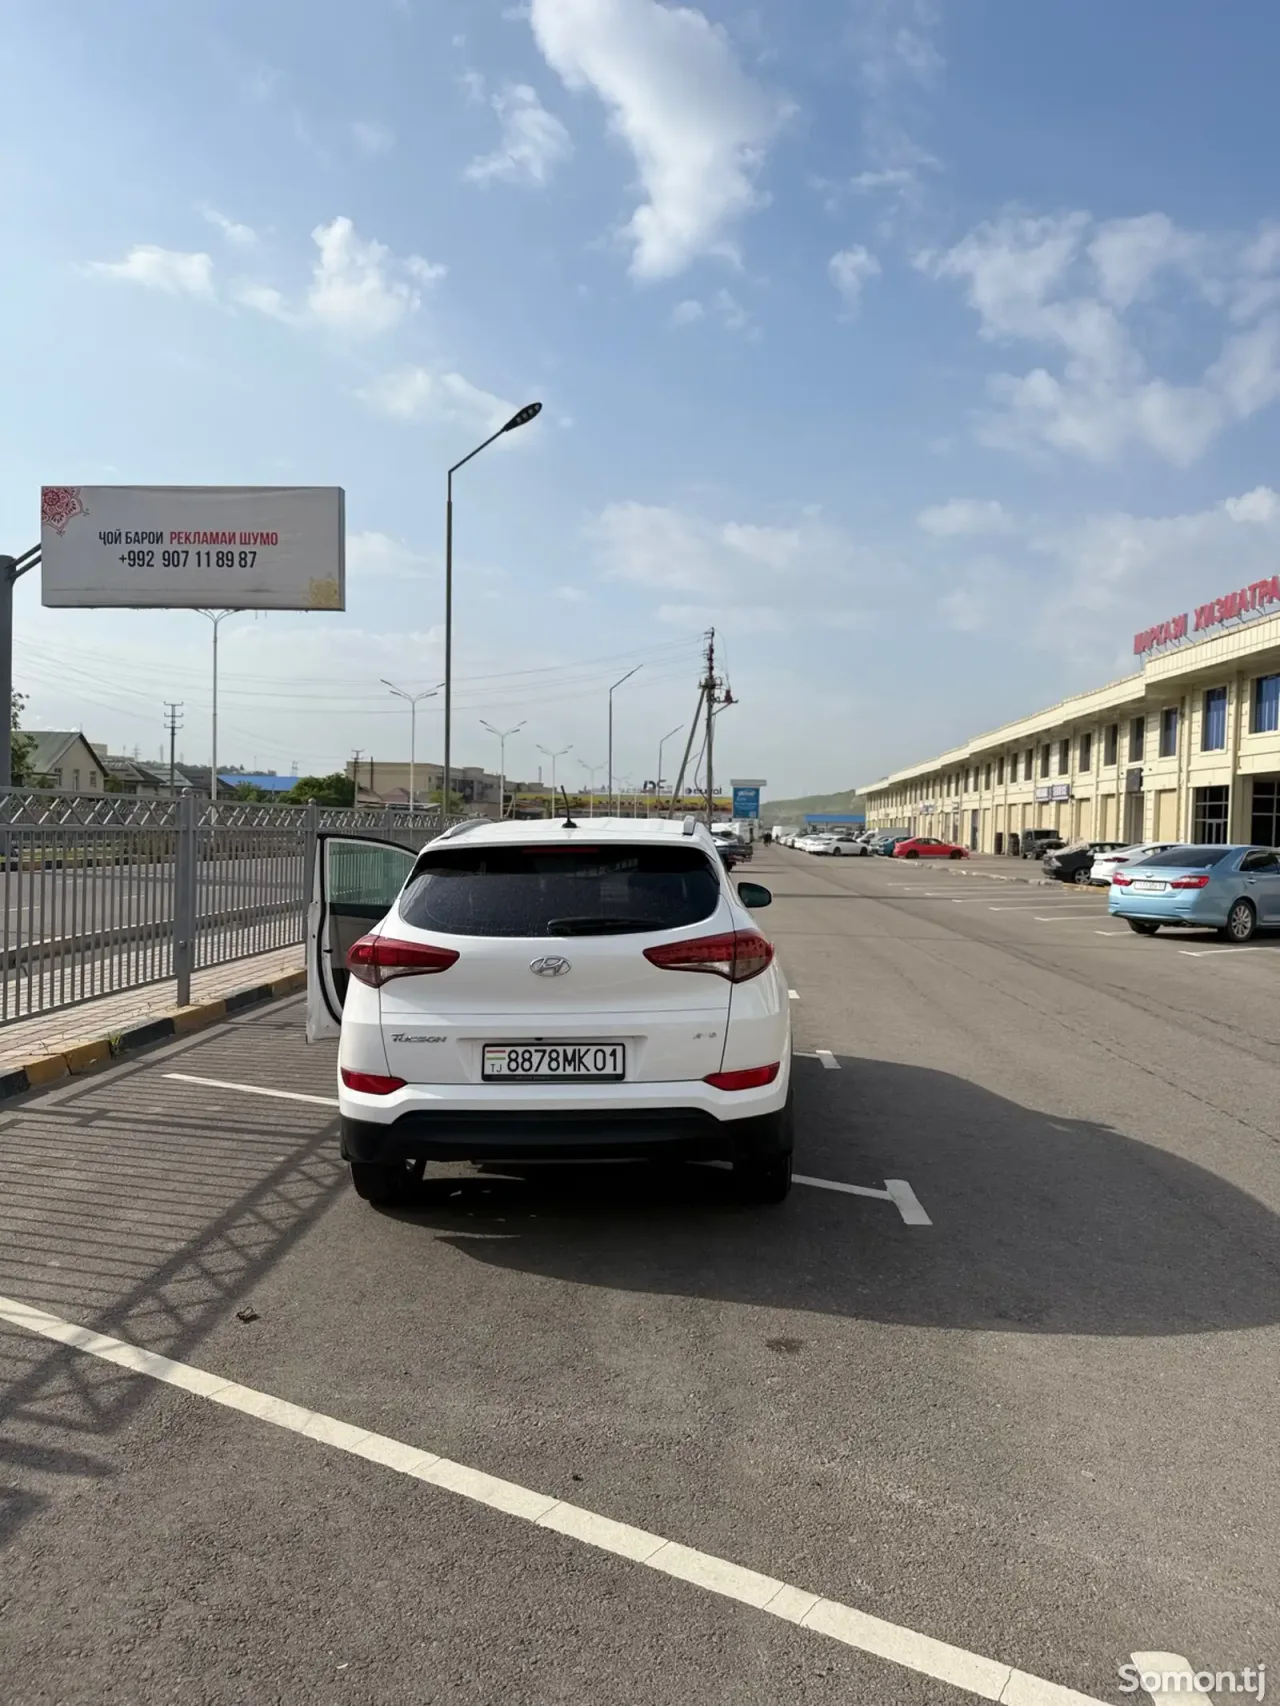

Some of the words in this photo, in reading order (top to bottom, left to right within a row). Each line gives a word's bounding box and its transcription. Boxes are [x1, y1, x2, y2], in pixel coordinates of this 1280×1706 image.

[125, 531, 163, 545] БАРОИ
[170, 531, 236, 545] РЕКЛАМАИ
[240, 532, 278, 546] ШУМО
[118, 550, 155, 568] +992
[162, 550, 189, 568] 907
[196, 550, 211, 568] 11
[215, 550, 235, 568] 89
[238, 550, 257, 568] 87
[490, 1063, 502, 1073] TJ
[507, 1048, 617, 1073] 8878MK01
